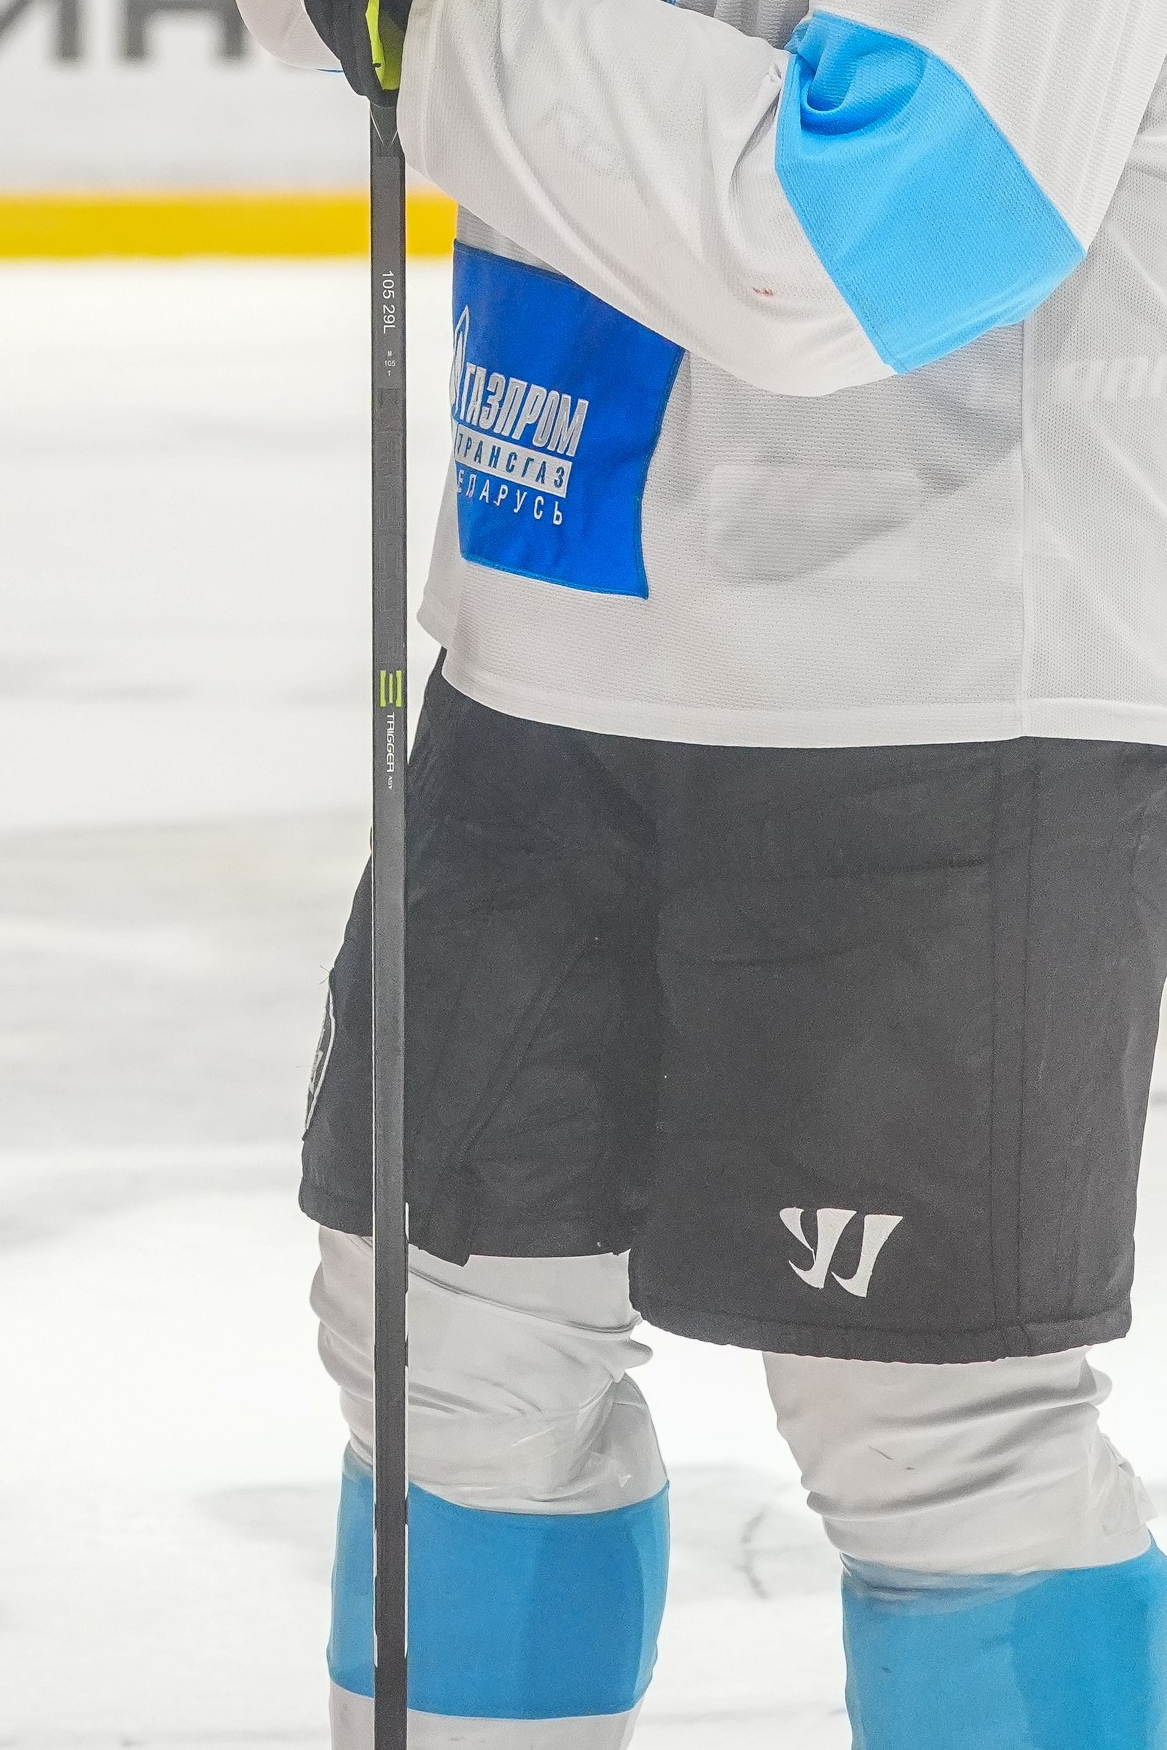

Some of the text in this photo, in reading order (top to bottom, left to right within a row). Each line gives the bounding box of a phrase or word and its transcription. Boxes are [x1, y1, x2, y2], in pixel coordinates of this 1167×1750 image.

[382, 270, 396, 334] 105 29L
[459, 361, 590, 458] ГАЗПРОМ
[386, 711, 395, 773] TRIGGER
